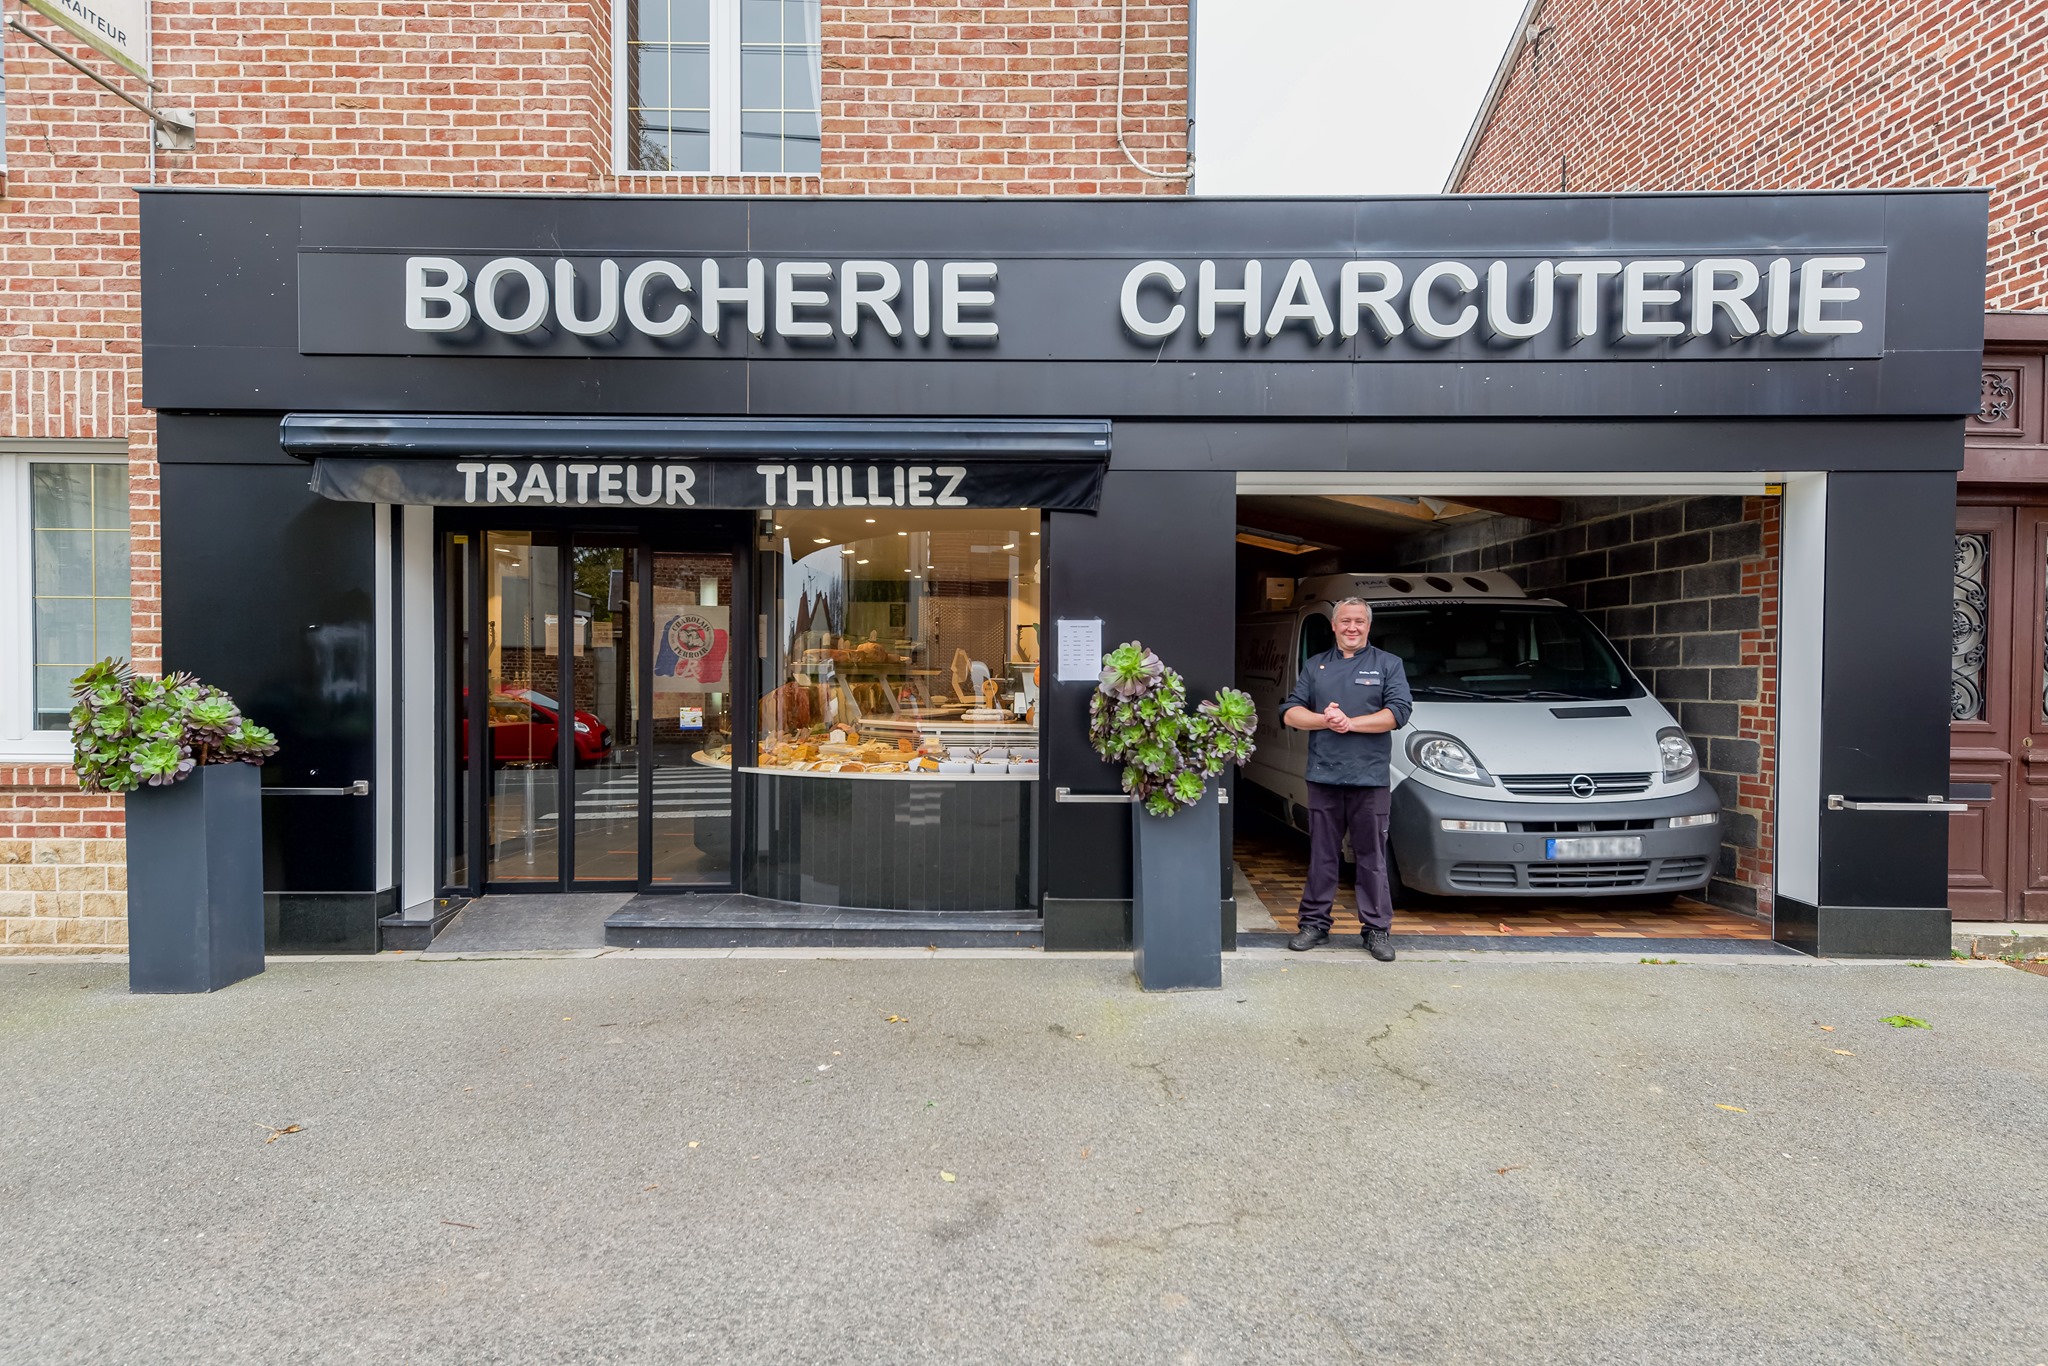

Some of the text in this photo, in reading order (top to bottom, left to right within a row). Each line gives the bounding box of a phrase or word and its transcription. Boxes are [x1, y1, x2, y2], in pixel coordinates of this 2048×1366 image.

[405, 256, 1867, 340] BOUCHERIE CHARCUTERIE
[456, 462, 969, 507] TRAITEUR THILLIEZ
[672, 616, 711, 633] CHAROLAIS
[674, 646, 709, 659] TERROIR
